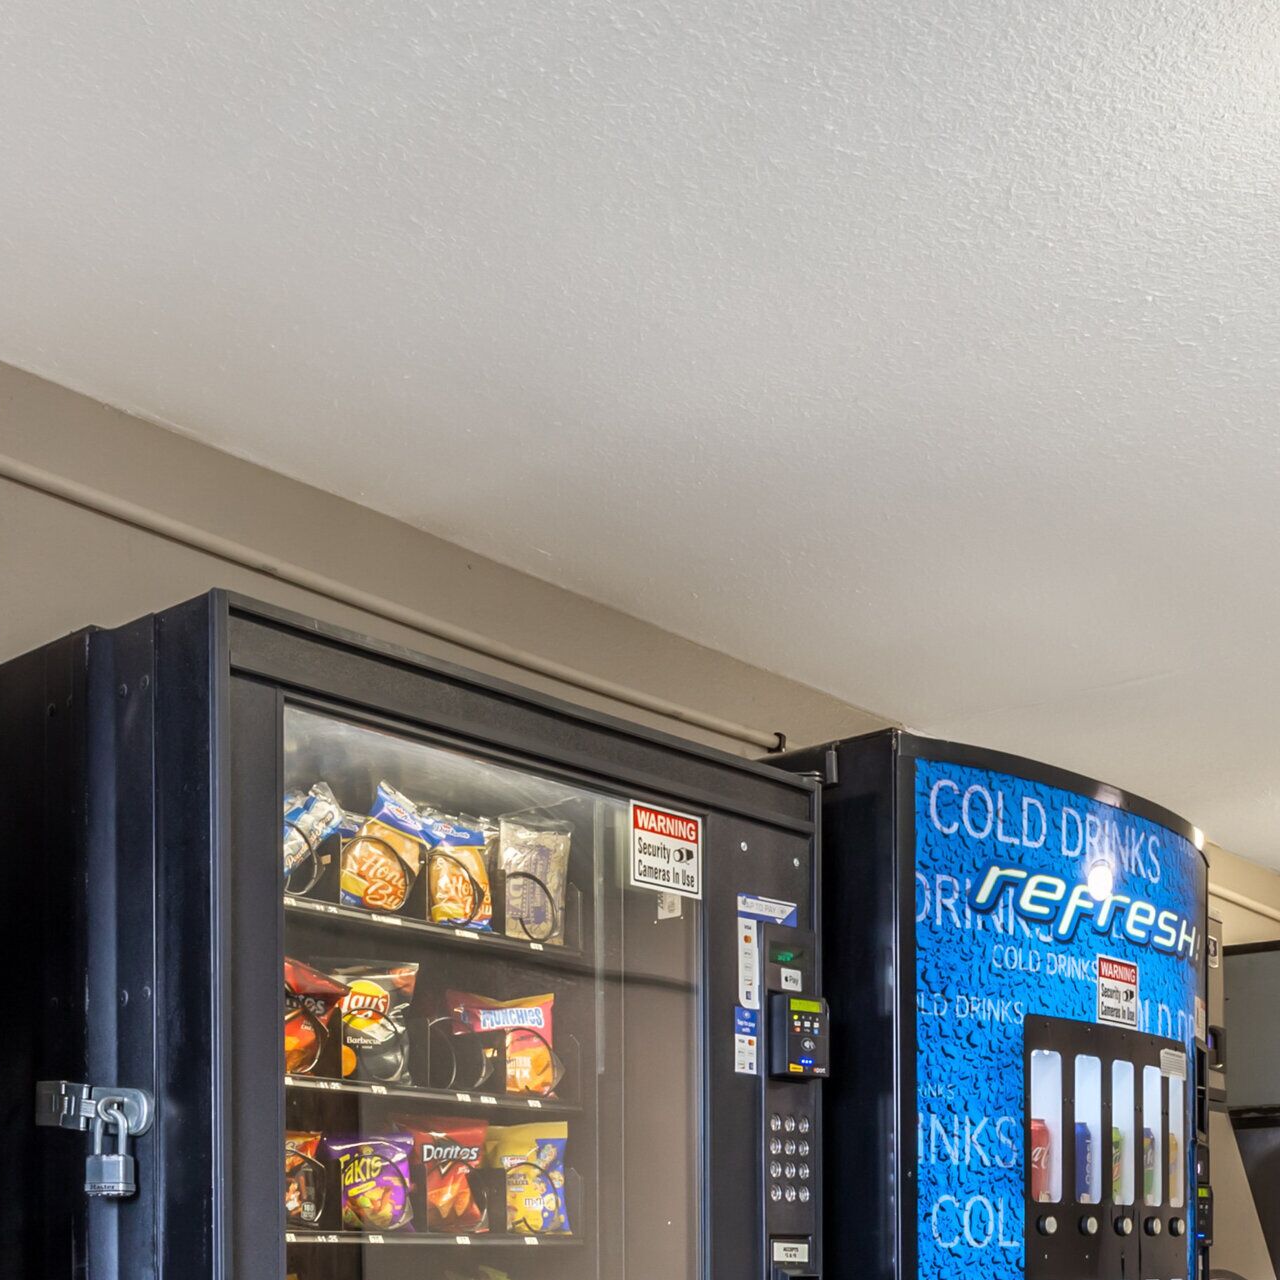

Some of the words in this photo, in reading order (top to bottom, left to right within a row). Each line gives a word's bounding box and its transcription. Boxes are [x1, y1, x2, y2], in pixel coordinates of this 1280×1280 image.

[636, 809, 697, 841] WARNING
[930, 778, 1048, 849] COLD
[1061, 806, 1161, 885] DRINKS
[638, 836, 672, 864] Security
[638, 859, 671, 883] Cameras
[673, 867, 681, 885] In
[682, 869, 695, 888] Use
[991, 944, 1040, 973] COLD
[1046, 951, 1099, 982] DRINKS
[1100, 960, 1137, 983] WARNING
[1101, 982, 1121, 1004] Security
[956, 995, 1025, 1025] DRINKS
[1101, 1001, 1121, 1018] Cameras
[422, 1144, 479, 1163] Doritos
